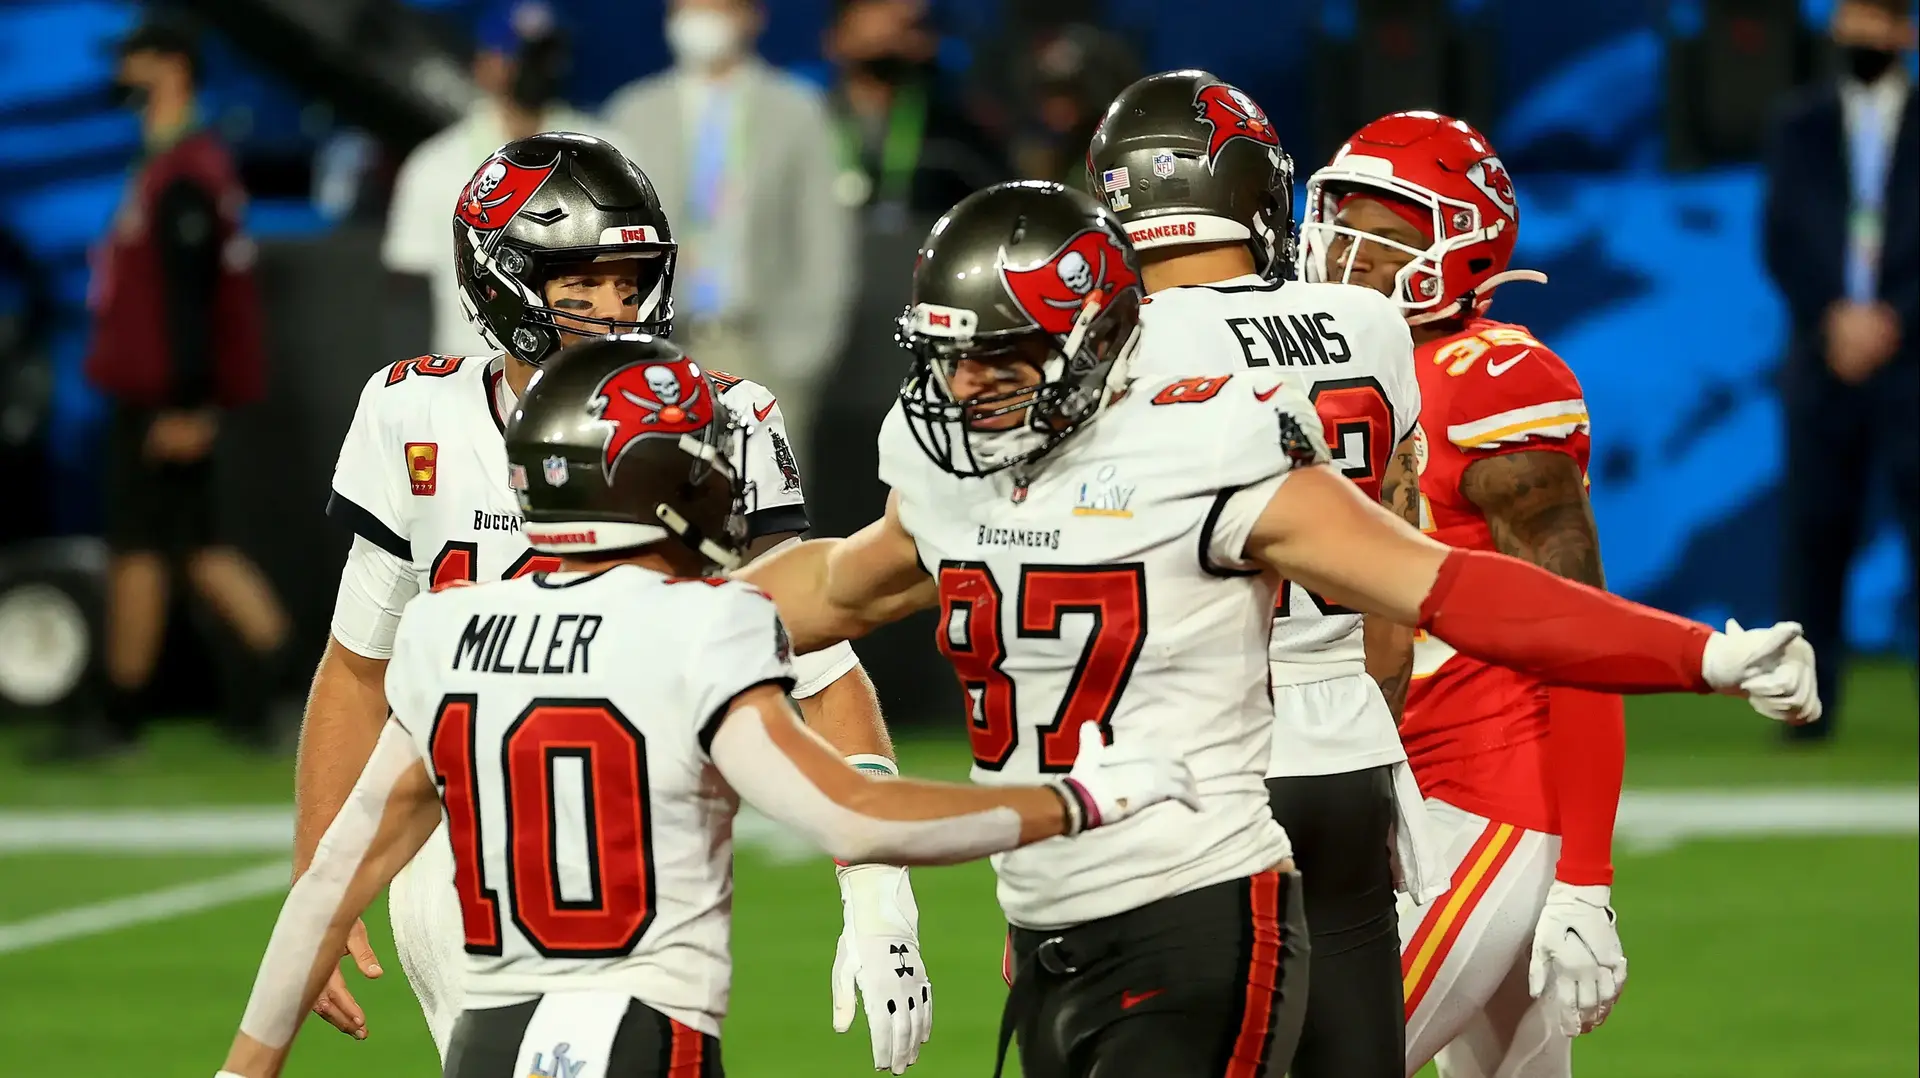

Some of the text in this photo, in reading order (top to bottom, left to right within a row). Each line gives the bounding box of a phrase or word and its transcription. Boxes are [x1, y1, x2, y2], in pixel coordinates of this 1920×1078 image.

[1156, 163, 1172, 174] NFL
[1128, 221, 1197, 244] UCCANEERS
[1225, 312, 1351, 368] EVANS
[408, 445, 436, 482] C
[977, 525, 1061, 550] BUCCANEERS
[452, 614, 603, 674] MILLER
[936, 559, 1148, 774] 87
[430, 693, 657, 959] 10
